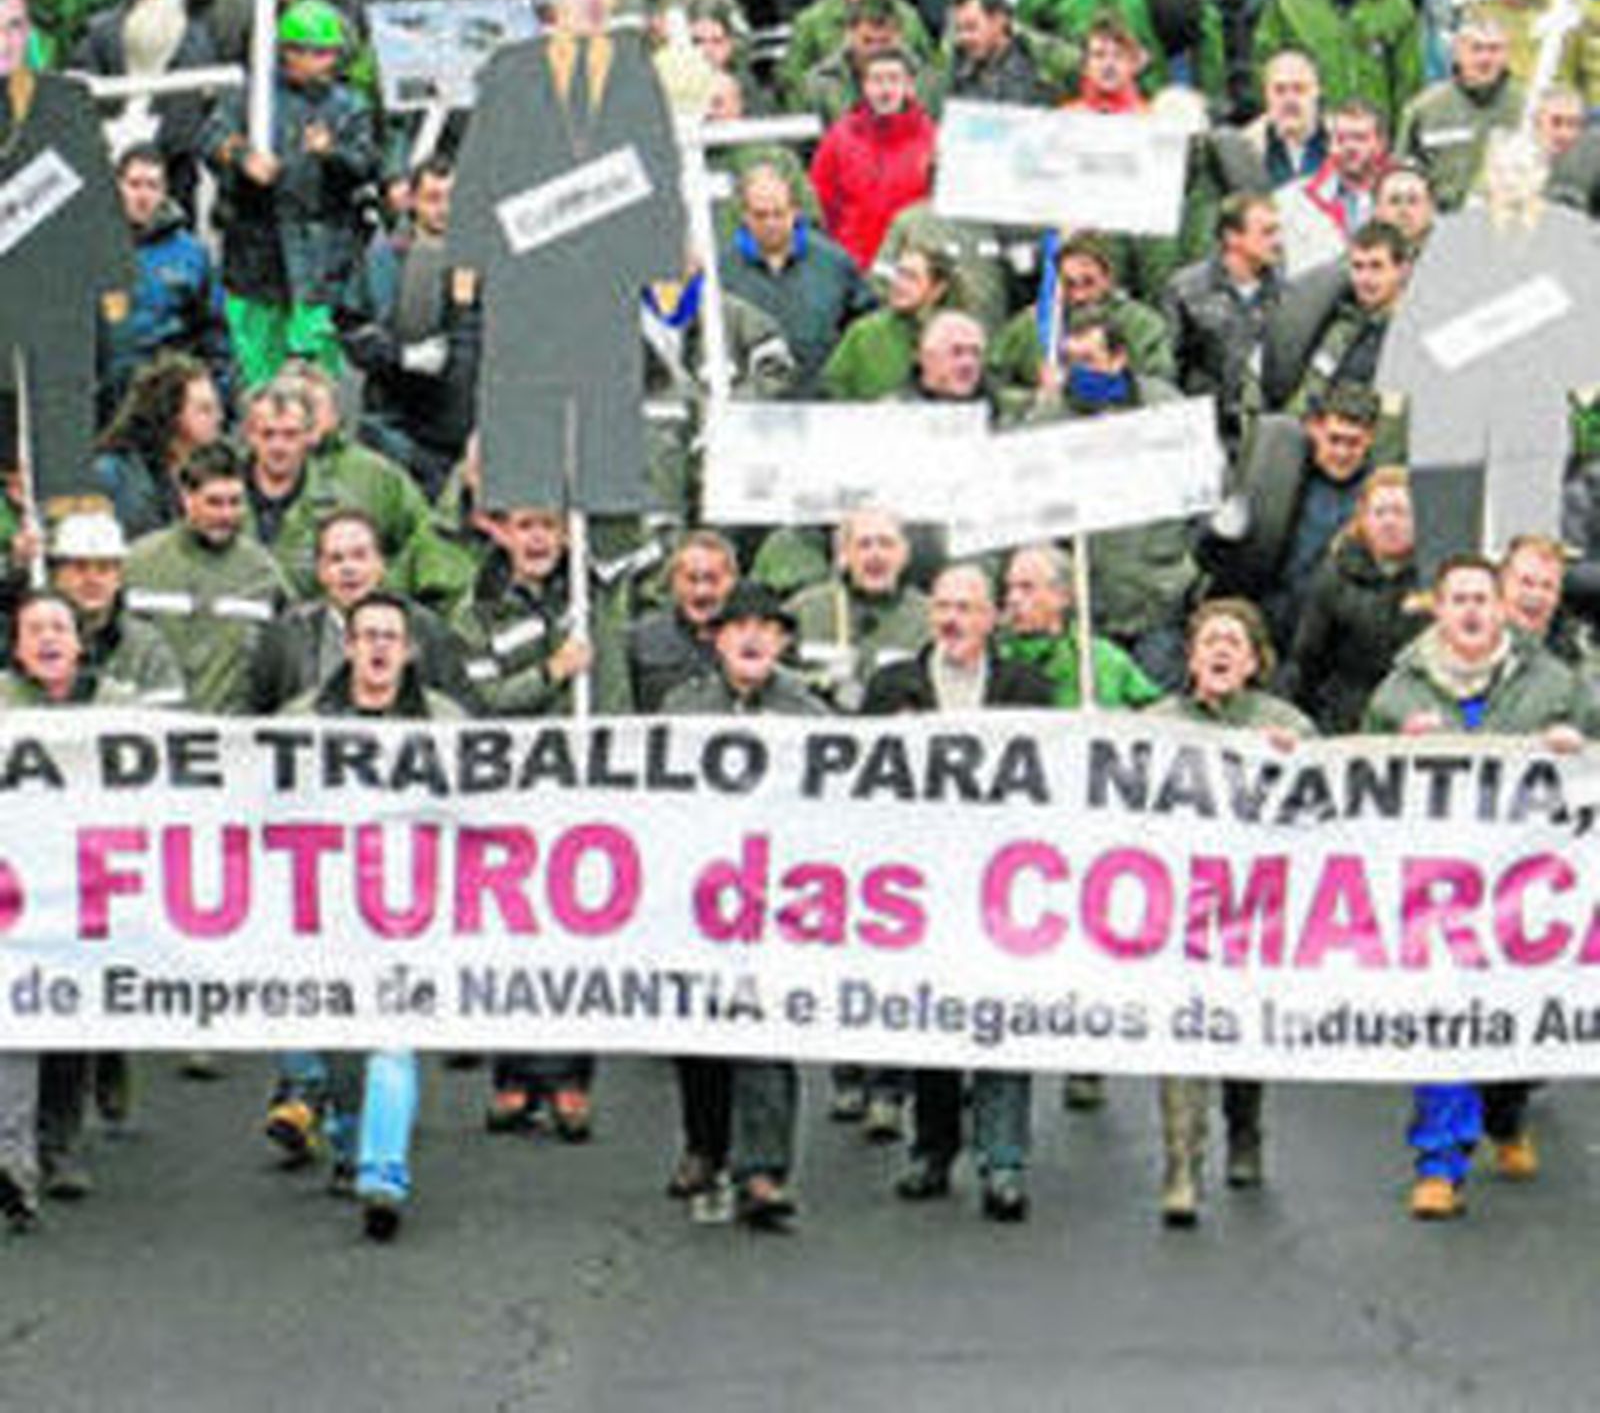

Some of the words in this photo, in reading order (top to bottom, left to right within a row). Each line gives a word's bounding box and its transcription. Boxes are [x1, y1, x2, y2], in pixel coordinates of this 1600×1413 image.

[0, 736, 67, 793] A
[96, 728, 226, 790] DE
[252, 724, 769, 798] TRABALLO
[799, 733, 1051, 805] PARA
[1087, 738, 1594, 838] NAVANTIA,
[76, 820, 642, 941] FUTURO
[691, 832, 927, 950] das
[980, 838, 1600, 970] COMARC
[11, 965, 81, 1015] de
[102, 966, 356, 1026] Empresa
[376, 964, 437, 1015] de
[459, 967, 765, 1022] NAVANTIA
[785, 988, 817, 1025] e
[839, 980, 1148, 1043] Delegados
[1172, 995, 1240, 1043] da
[1261, 997, 1517, 1049] Industria
